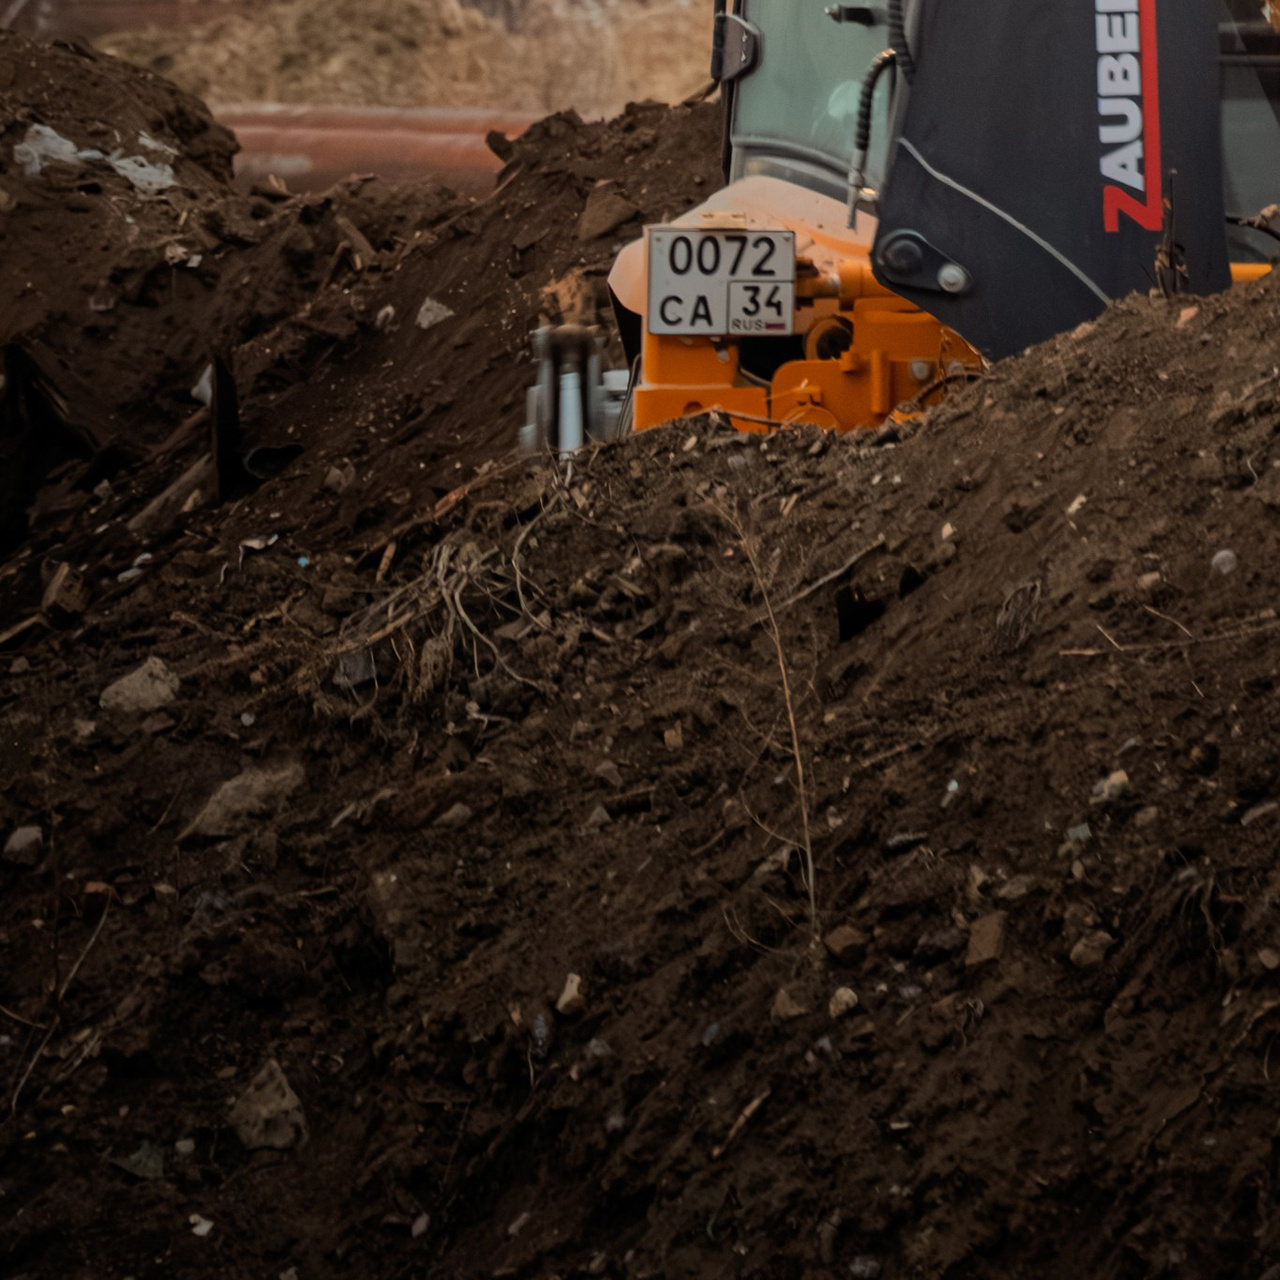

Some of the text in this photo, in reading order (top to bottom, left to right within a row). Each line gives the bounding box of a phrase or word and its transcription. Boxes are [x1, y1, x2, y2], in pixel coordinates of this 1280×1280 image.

[668, 235, 776, 276] 0072
[741, 285, 783, 317] 34
[731, 318, 764, 331] RUS
